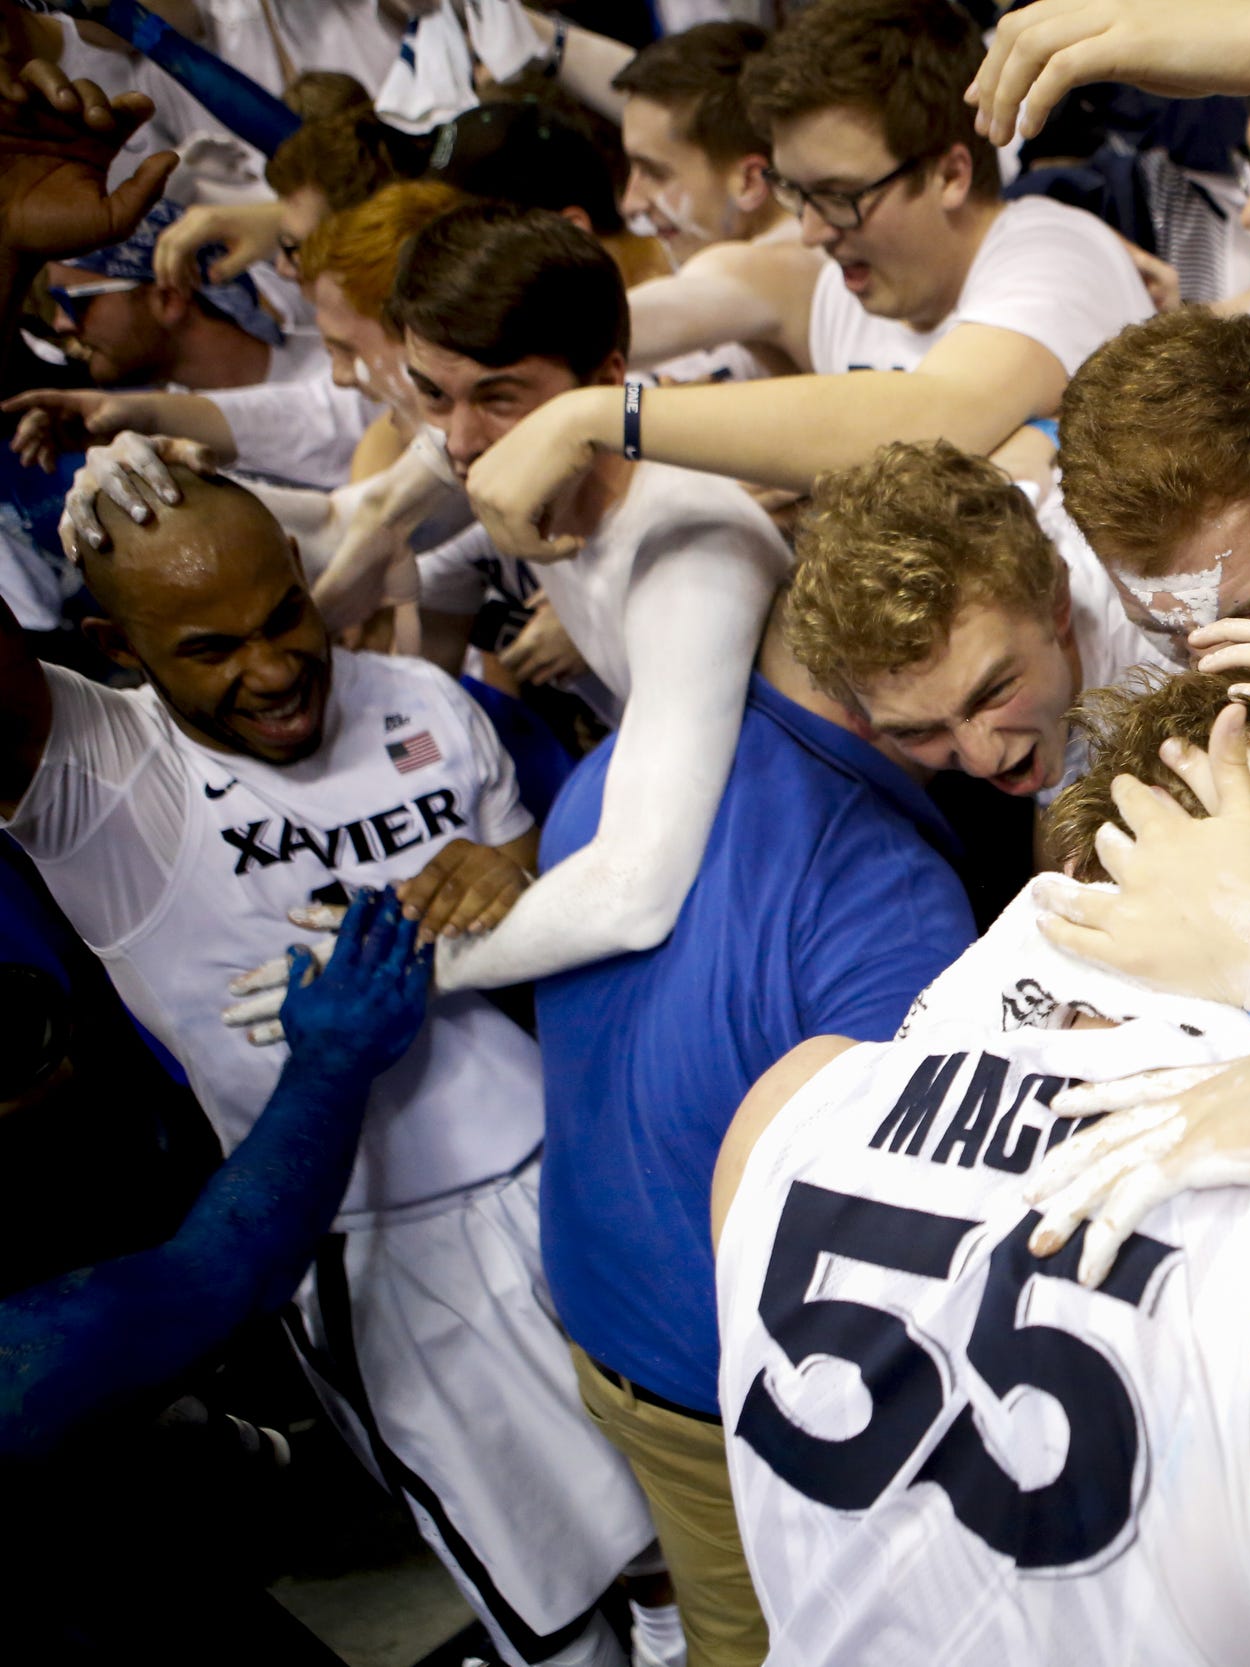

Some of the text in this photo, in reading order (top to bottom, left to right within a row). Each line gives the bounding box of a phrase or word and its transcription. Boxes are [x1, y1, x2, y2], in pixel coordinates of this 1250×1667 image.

[221, 788, 468, 876] XAVIER
[867, 1050, 1112, 1176] MAC
[735, 1180, 1184, 1578] 55
